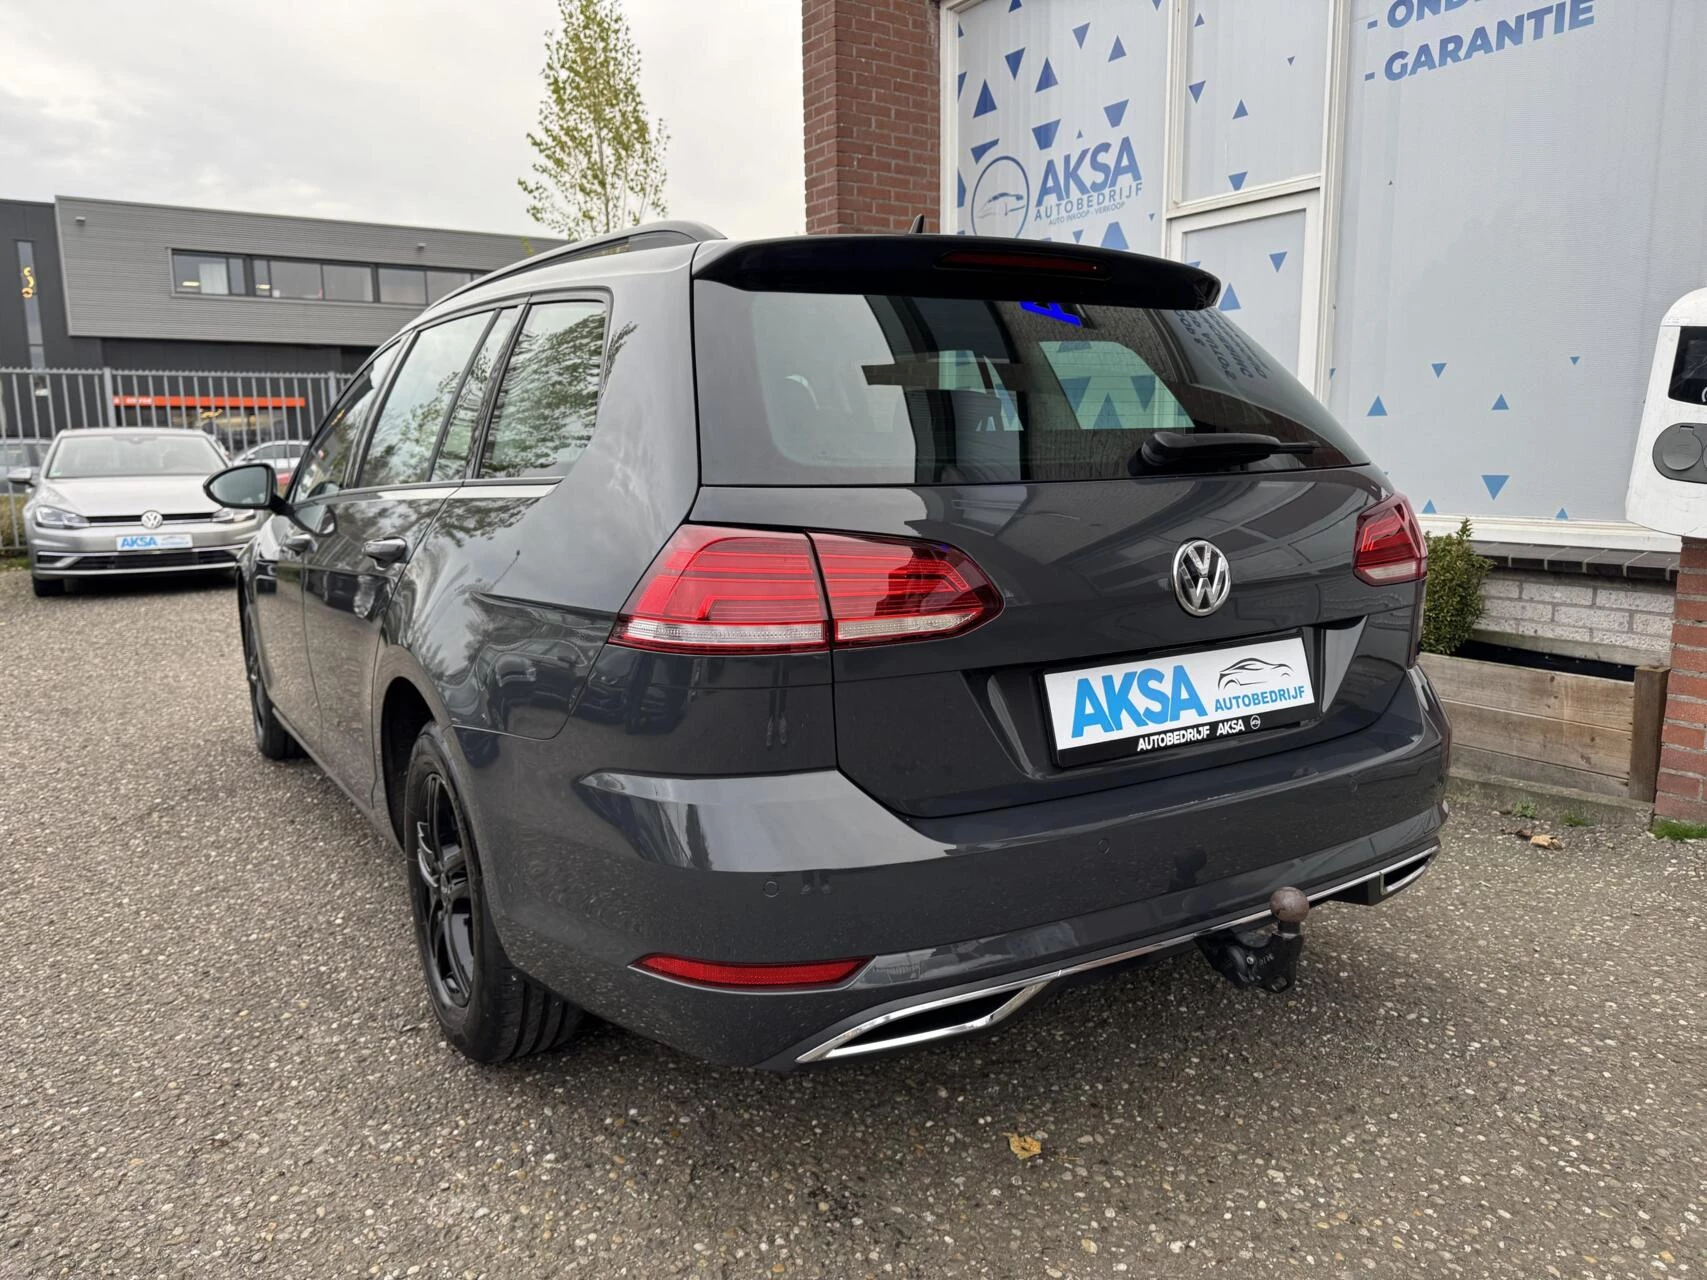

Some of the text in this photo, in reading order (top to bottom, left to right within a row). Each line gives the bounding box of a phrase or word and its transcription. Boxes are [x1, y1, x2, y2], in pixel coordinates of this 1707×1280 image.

[1384, 0, 1595, 81] GARANTIE
[1035, 136, 1142, 208] AKSA
[1035, 182, 1143, 222] AUTOBEDRIJF
[121, 536, 158, 548] AKSA
[1071, 664, 1208, 739] AKSA
[1214, 685, 1305, 713] AUTOBEDRIJF
[1137, 718, 1246, 752] AUTOBEDRIJF AKSA
